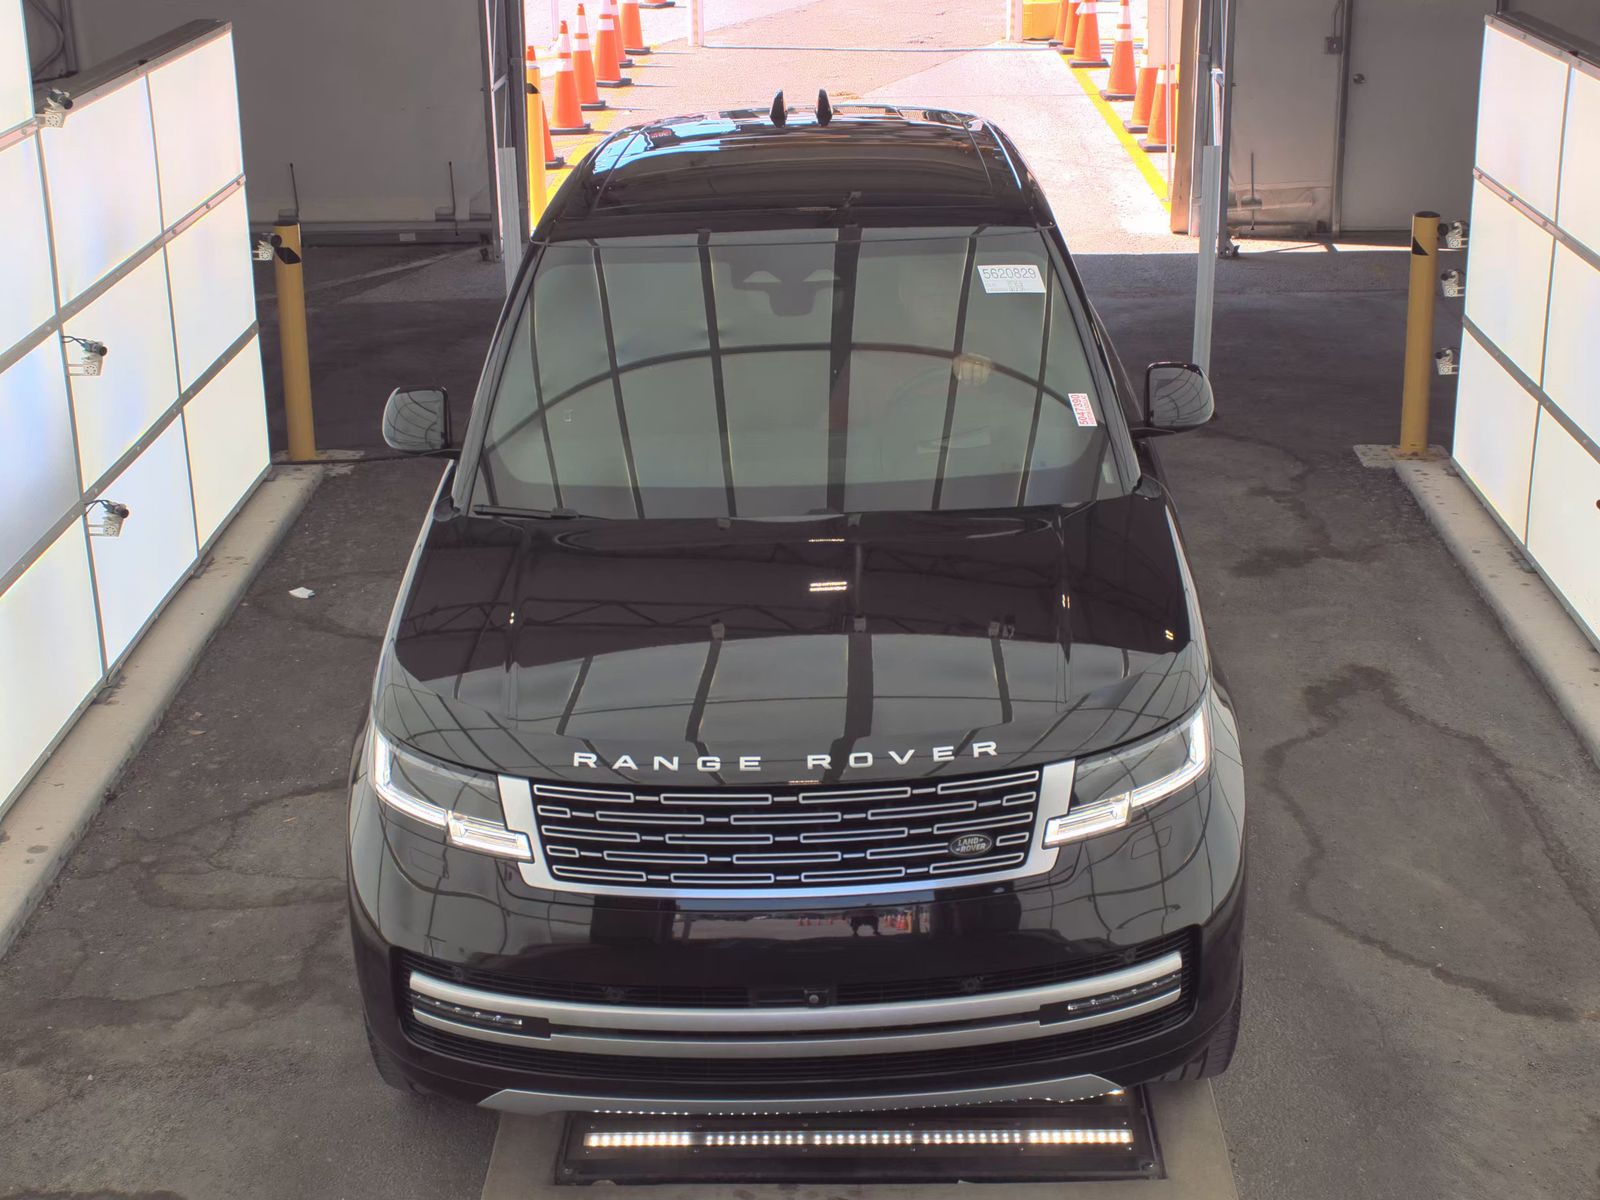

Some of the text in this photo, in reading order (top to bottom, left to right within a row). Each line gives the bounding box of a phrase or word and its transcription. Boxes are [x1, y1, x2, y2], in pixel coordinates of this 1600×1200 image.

[982, 267, 1037, 280] 5620829
[1070, 394, 1088, 425] 5047390
[573, 740, 999, 772] RANGE ROVER
